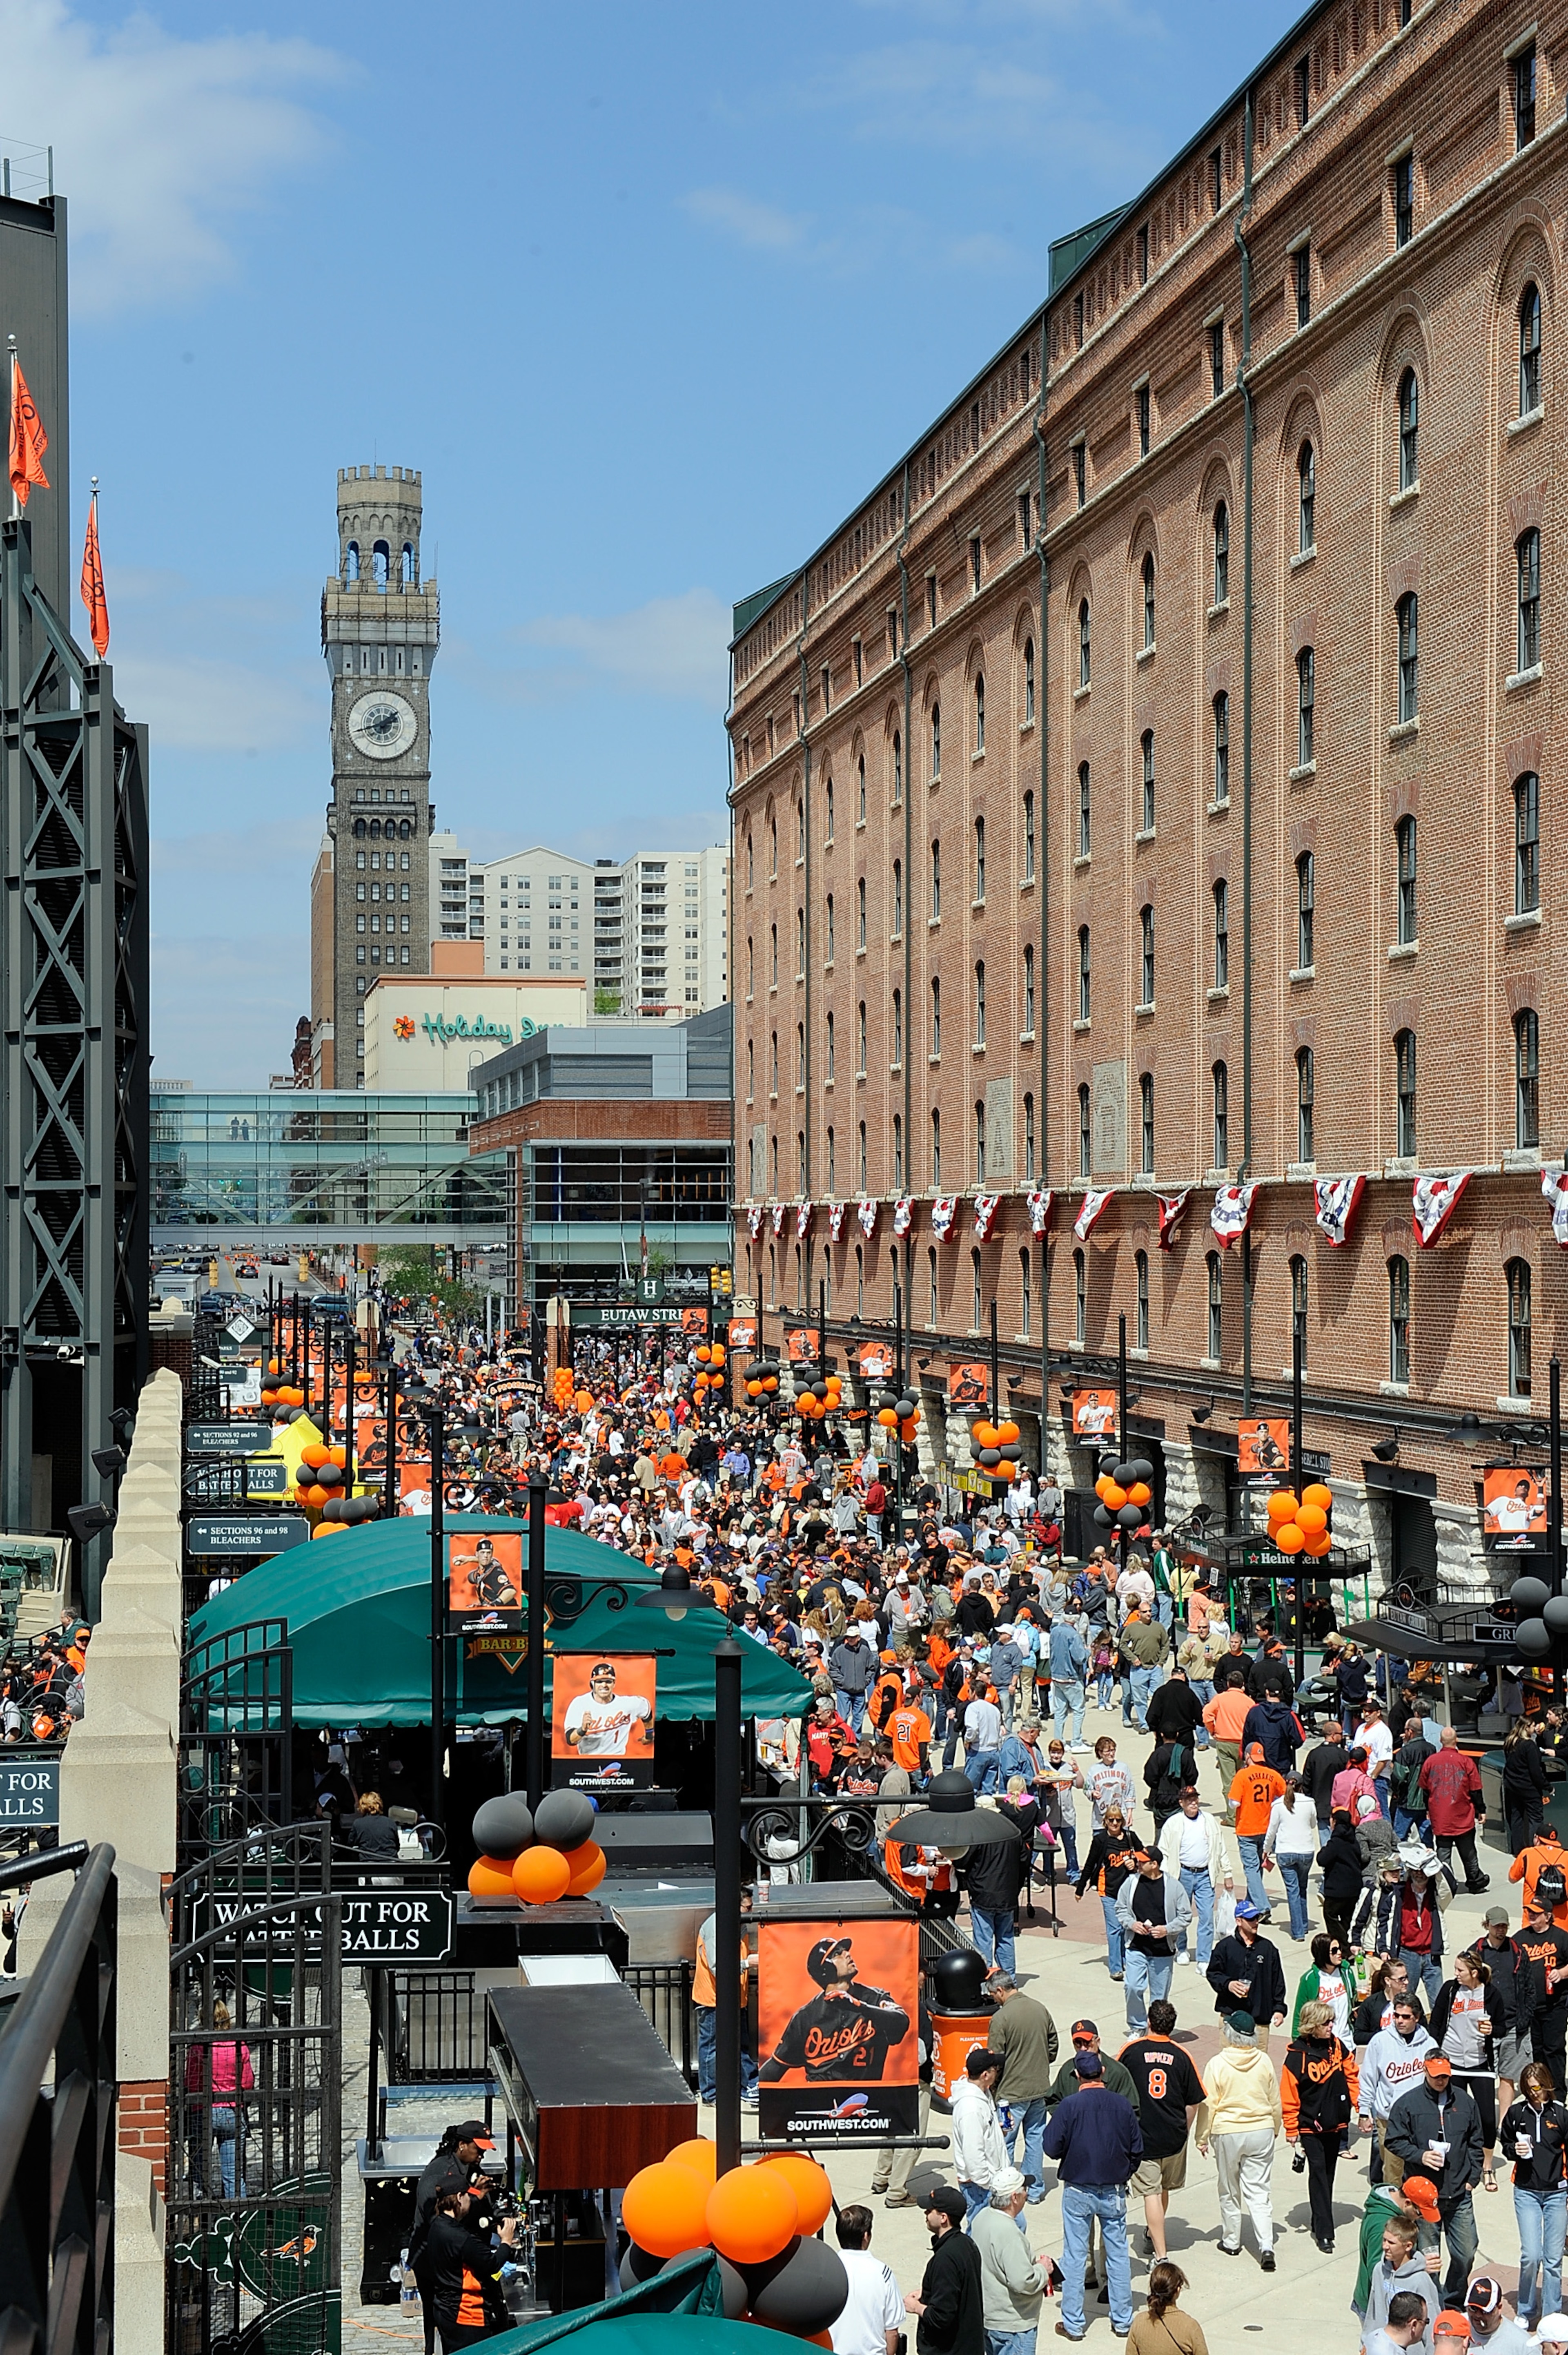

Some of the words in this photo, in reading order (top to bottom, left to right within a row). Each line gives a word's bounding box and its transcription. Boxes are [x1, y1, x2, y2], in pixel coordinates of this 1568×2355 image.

[421, 1013, 512, 1043] Holiday
[643, 1280, 657, 1295] H
[601, 1309, 649, 1320] EUTAW
[653, 1309, 683, 1320] STRE
[233, 1469, 256, 1478] OT
[258, 1469, 278, 1478] FOR
[247, 1481, 274, 1489] ALLS
[254, 1526, 263, 1534] 96
[1261, 1553, 1320, 1565] Heineen
[1492, 1628, 1516, 1640] GRI
[897, 1722, 911, 1743] 21
[8, 1773, 53, 1791] FOR
[1248, 1773, 1274, 1782] MARKAKIS
[1253, 1784, 1270, 1803] 21
[377, 1902, 431, 1923] FOR
[341, 1929, 420, 1950] BALLS
[804, 2018, 875, 2067] Orioles
[853, 2046, 874, 2067] 21
[1144, 2051, 1174, 2065] RIPKEN
[1386, 2058, 1425, 2084] Oriole
[1148, 2068, 1167, 2099] 8
[786, 2118, 889, 2131] SOUTHWEST.COM
